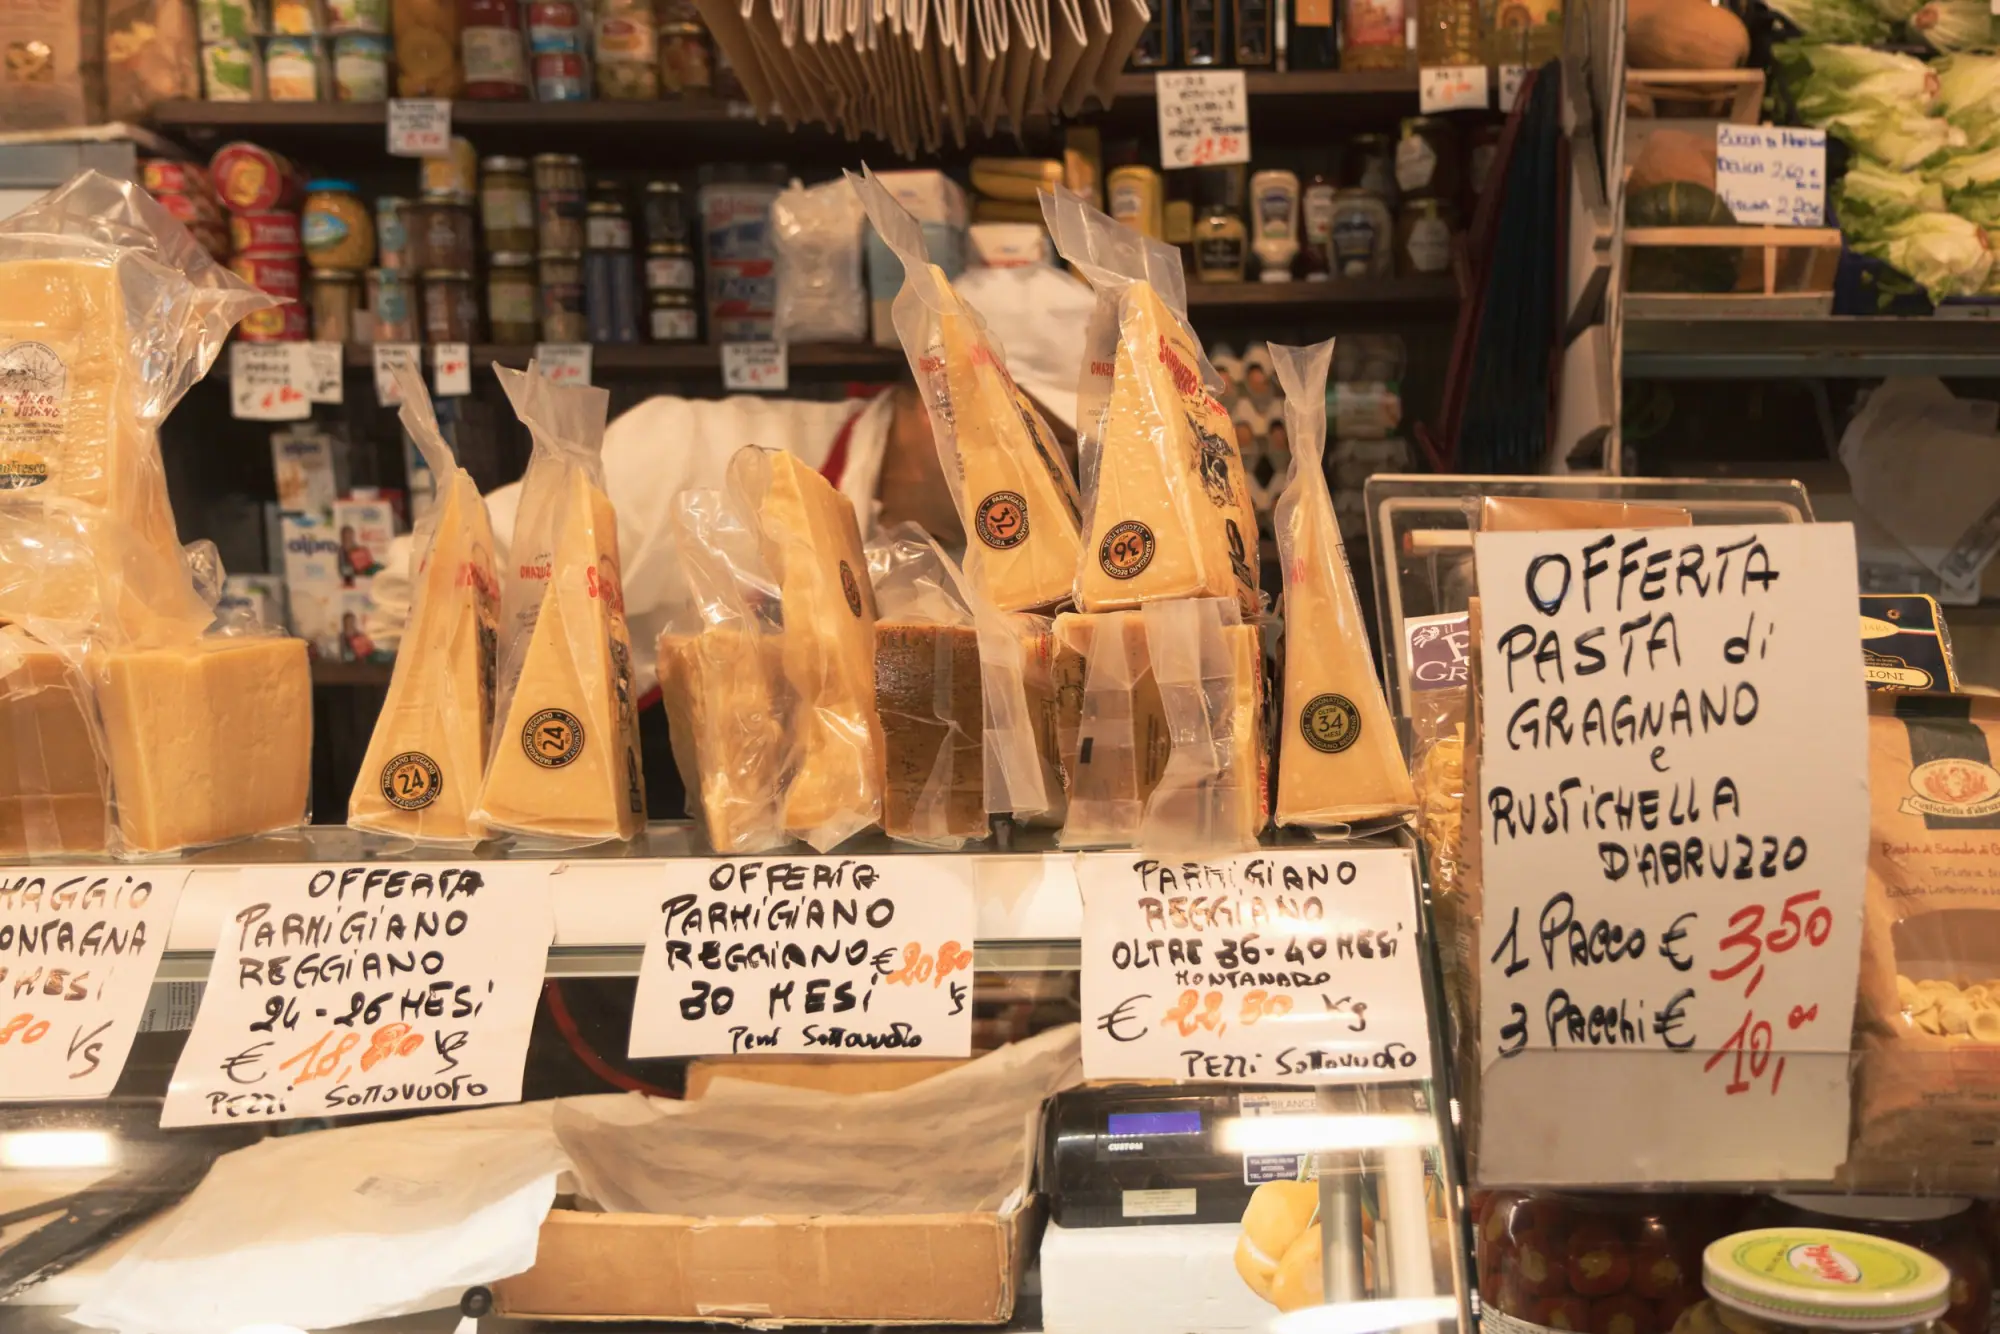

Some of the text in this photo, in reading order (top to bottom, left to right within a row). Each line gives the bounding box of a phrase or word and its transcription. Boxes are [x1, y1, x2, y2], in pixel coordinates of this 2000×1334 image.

[990, 507, 1016, 535] 32
[1114, 536, 1140, 562] 36
[1525, 534, 1780, 616] OFFERTA
[1497, 611, 1775, 693] PASTA di
[1318, 713, 1344, 733] 34
[1505, 681, 1760, 750] GRAGNANO
[542, 727, 565, 751] 24
[1650, 745, 1670, 773] e
[398, 768, 425, 795] 24
[1487, 776, 1740, 845] RUSTICHELLA
[708, 860, 881, 897] OFFERTA
[1132, 858, 1357, 896] PARMIGIANO
[1597, 834, 1808, 888] D'ABRUZZO
[308, 867, 486, 903] OFFERTA
[235, 901, 470, 952] PARMIGIANO
[661, 893, 895, 938] PARMIGIANO
[1137, 888, 1326, 933] REGGIANO
[664, 939, 869, 973] REGGIANO
[870, 947, 898, 976] €
[1111, 936, 1204, 971] OLTRE
[1336, 921, 1404, 961] MESI
[1490, 889, 1834, 999] 1 Pacco € 3,50
[13, 965, 115, 1002] MESI
[238, 948, 445, 990] REGGIANO
[400, 979, 496, 1021] MESI
[768, 971, 880, 1021] MESI
[1097, 993, 1153, 1042] €
[1498, 1001, 1529, 1058] 3
[1545, 988, 1647, 1052] Pacchi
[1652, 988, 1697, 1053] €
[220, 1041, 276, 1085] €
[1107, 1142, 1144, 1152] CUSTOM
